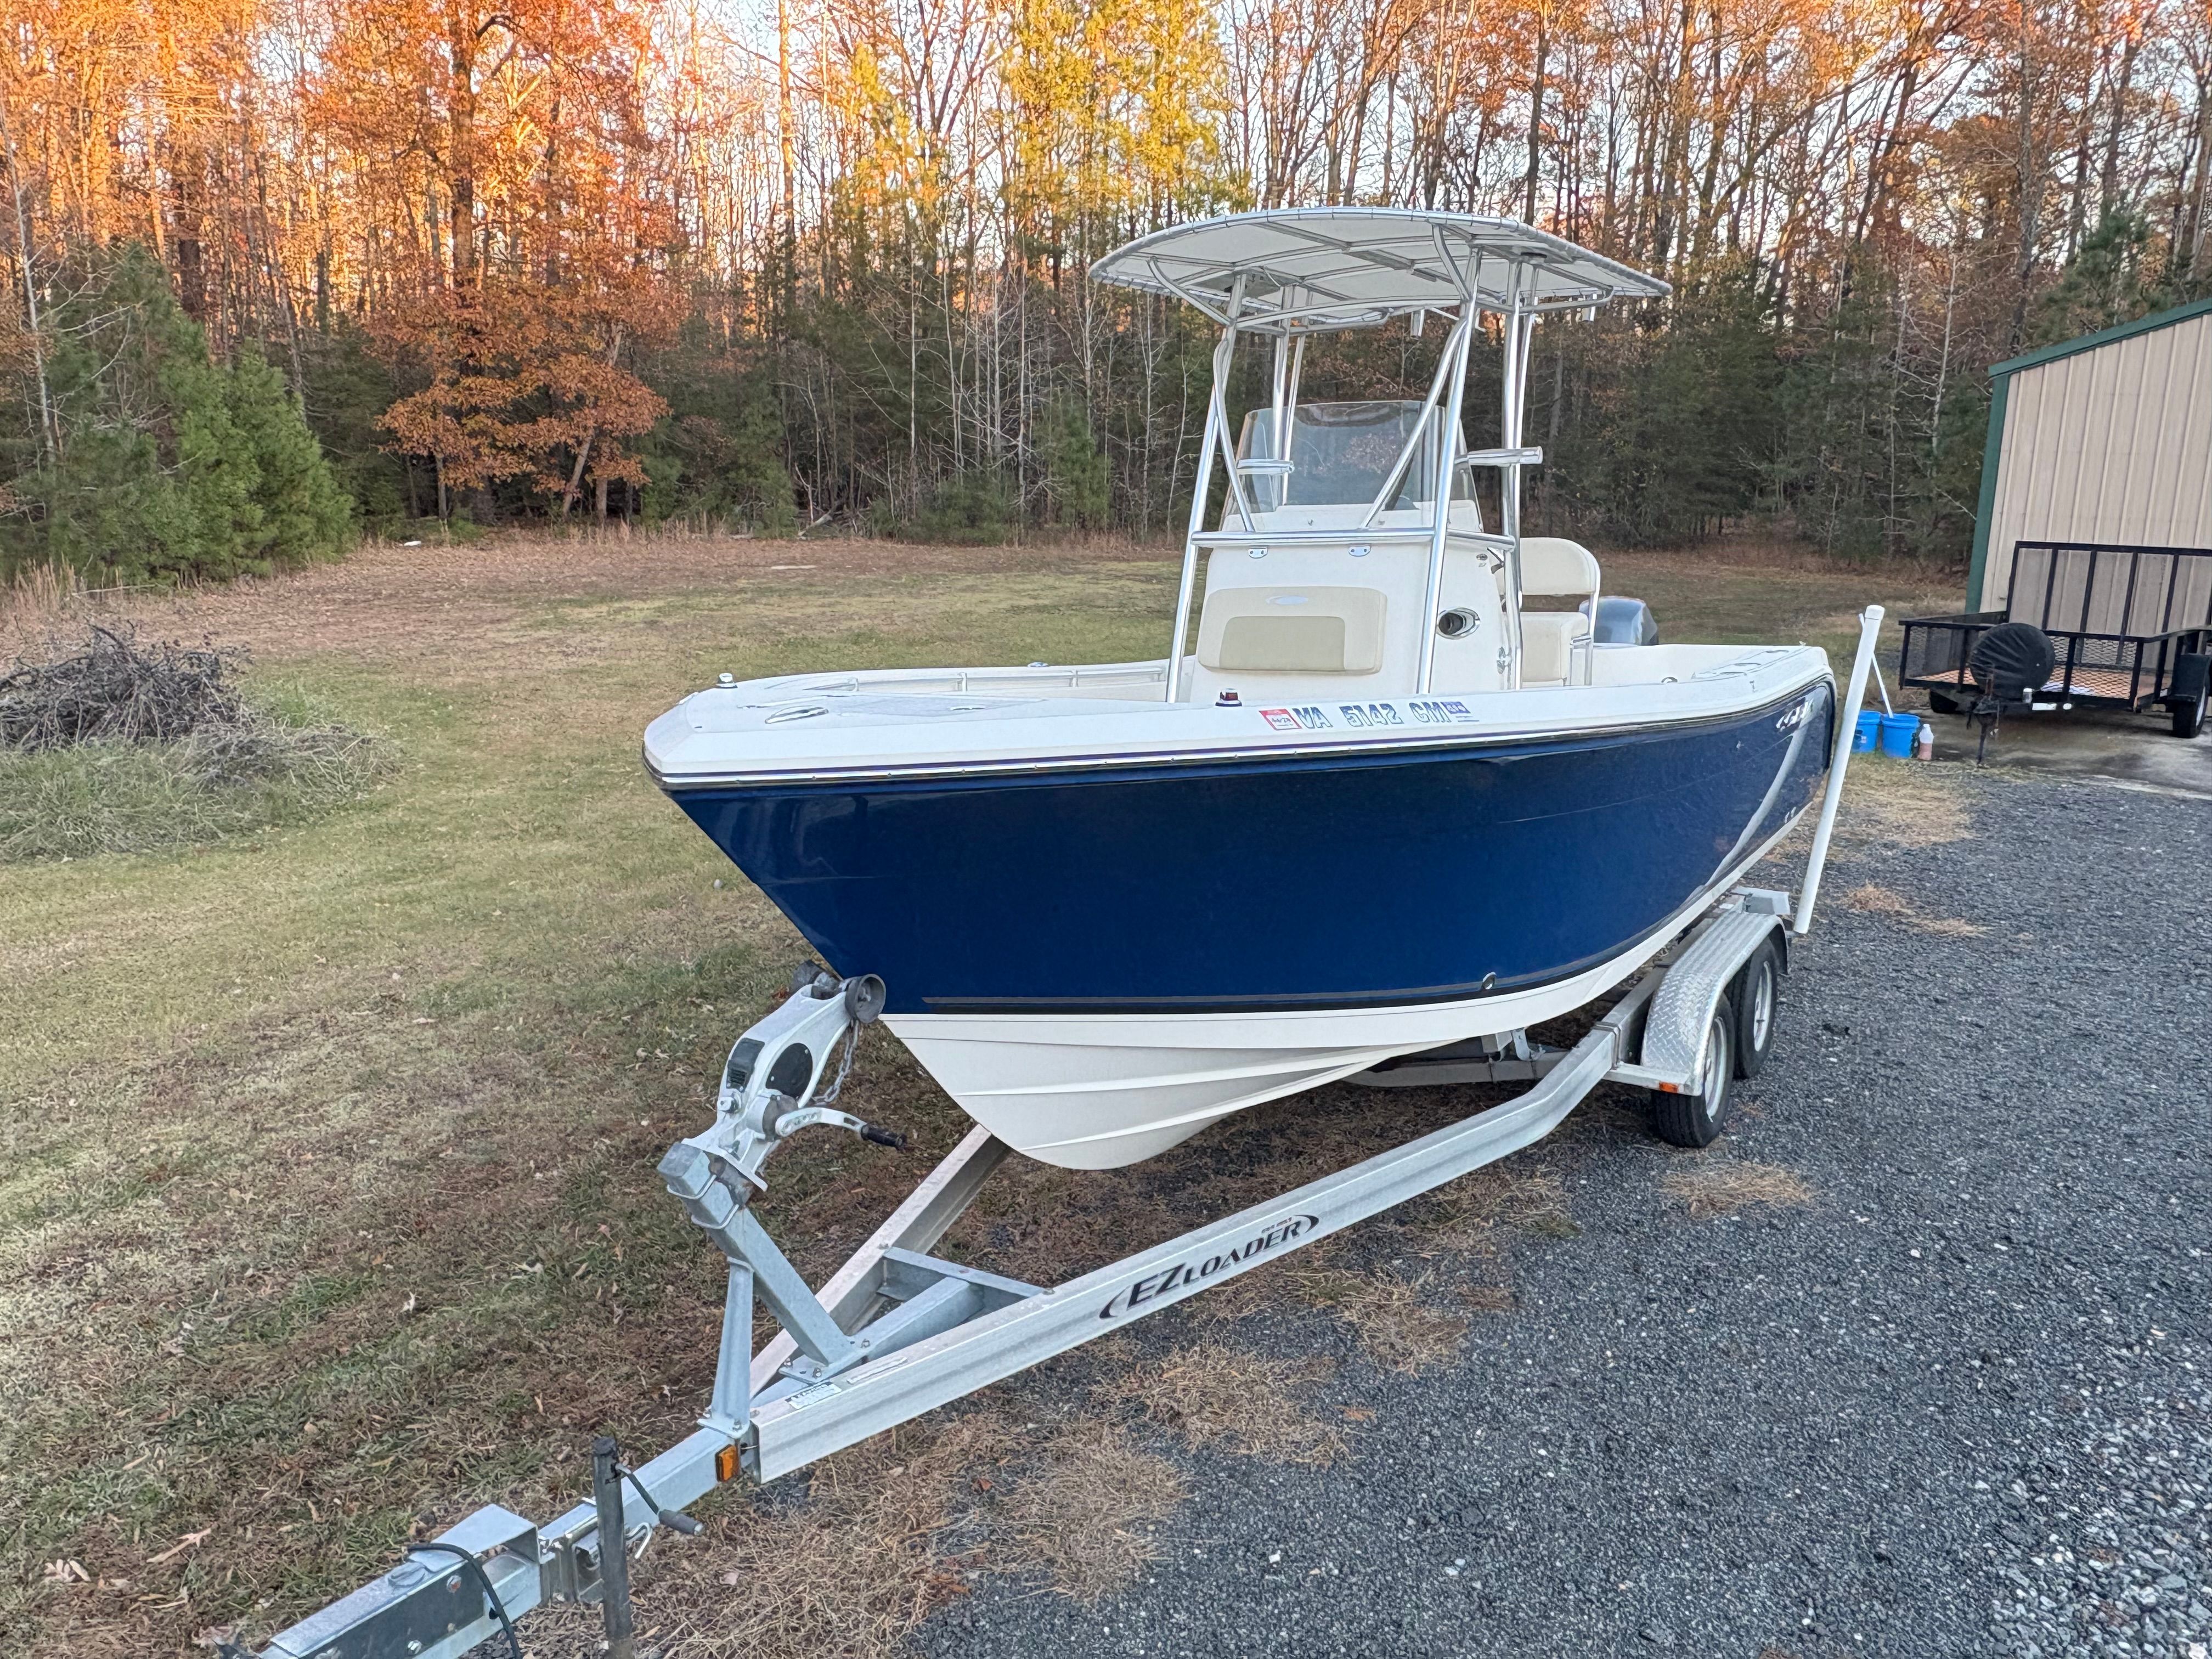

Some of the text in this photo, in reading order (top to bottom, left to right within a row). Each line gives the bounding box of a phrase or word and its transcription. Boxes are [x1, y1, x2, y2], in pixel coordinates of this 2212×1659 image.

[1292, 702, 1452, 729] VA 5142 CM
